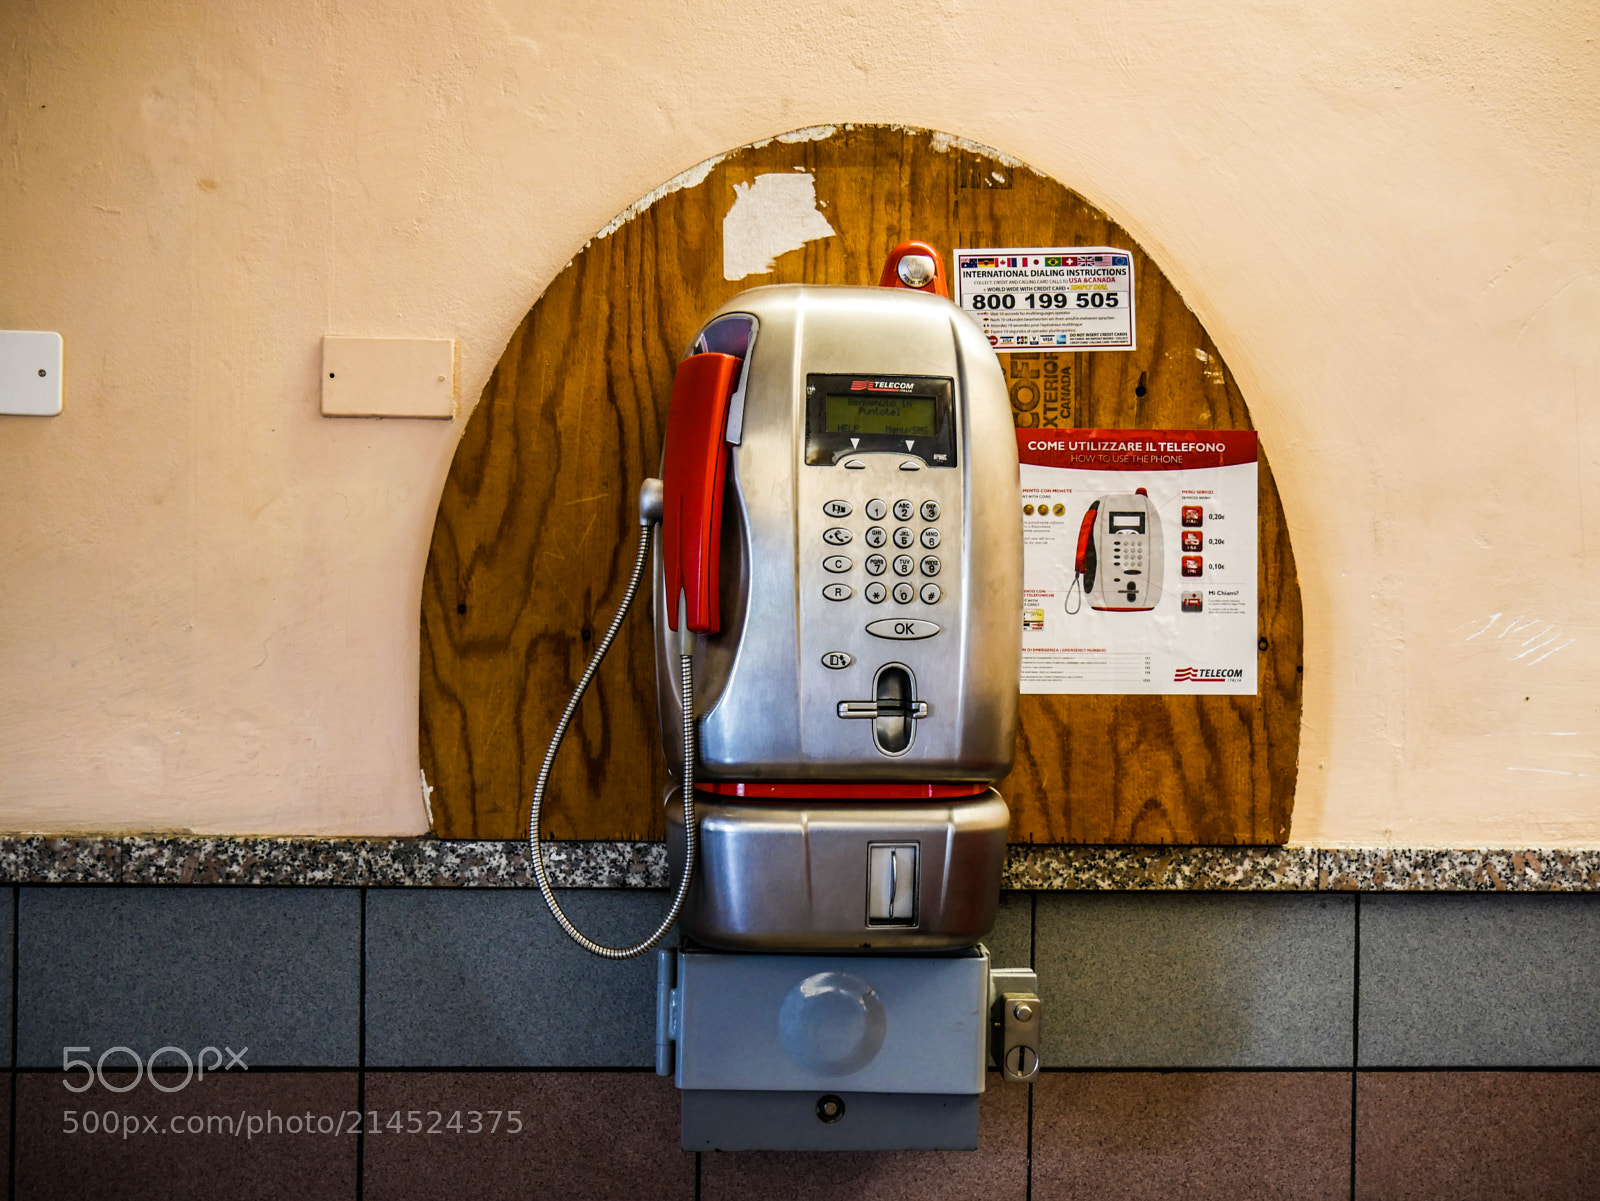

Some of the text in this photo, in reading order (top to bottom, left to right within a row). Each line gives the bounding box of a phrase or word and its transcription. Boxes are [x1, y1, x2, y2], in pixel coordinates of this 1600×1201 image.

[962, 268, 1127, 279] INTERNATIONAL DIALING INSTRUCTIONS
[972, 292, 1119, 310] 800 199 505
[874, 381, 914, 389] TELECOM
[1060, 366, 1072, 419] CANADA
[837, 424, 861, 433] HELP
[1027, 441, 1226, 453] COME UTILIZZARE IL TELEFONO
[1070, 455, 1183, 465] HOW TO USE THE PHONE
[874, 508, 879, 517] 1
[901, 509, 908, 518] 2
[928, 509, 935, 518] 3
[1208, 513, 1225, 521] 0,20€
[873, 536, 881, 545] 4
[901, 537, 908, 546] 5
[929, 537, 935, 546] 6
[1208, 538, 1225, 546] 0,20€
[834, 560, 843, 568] C
[1208, 563, 1225, 571] 0,10€
[874, 565, 881, 573] 7
[901, 565, 907, 573] 8
[928, 565, 935, 574] 9
[834, 588, 842, 596] R
[900, 592, 908, 601] 0
[894, 622, 916, 636] OK
[1199, 668, 1243, 678] TELECOM
